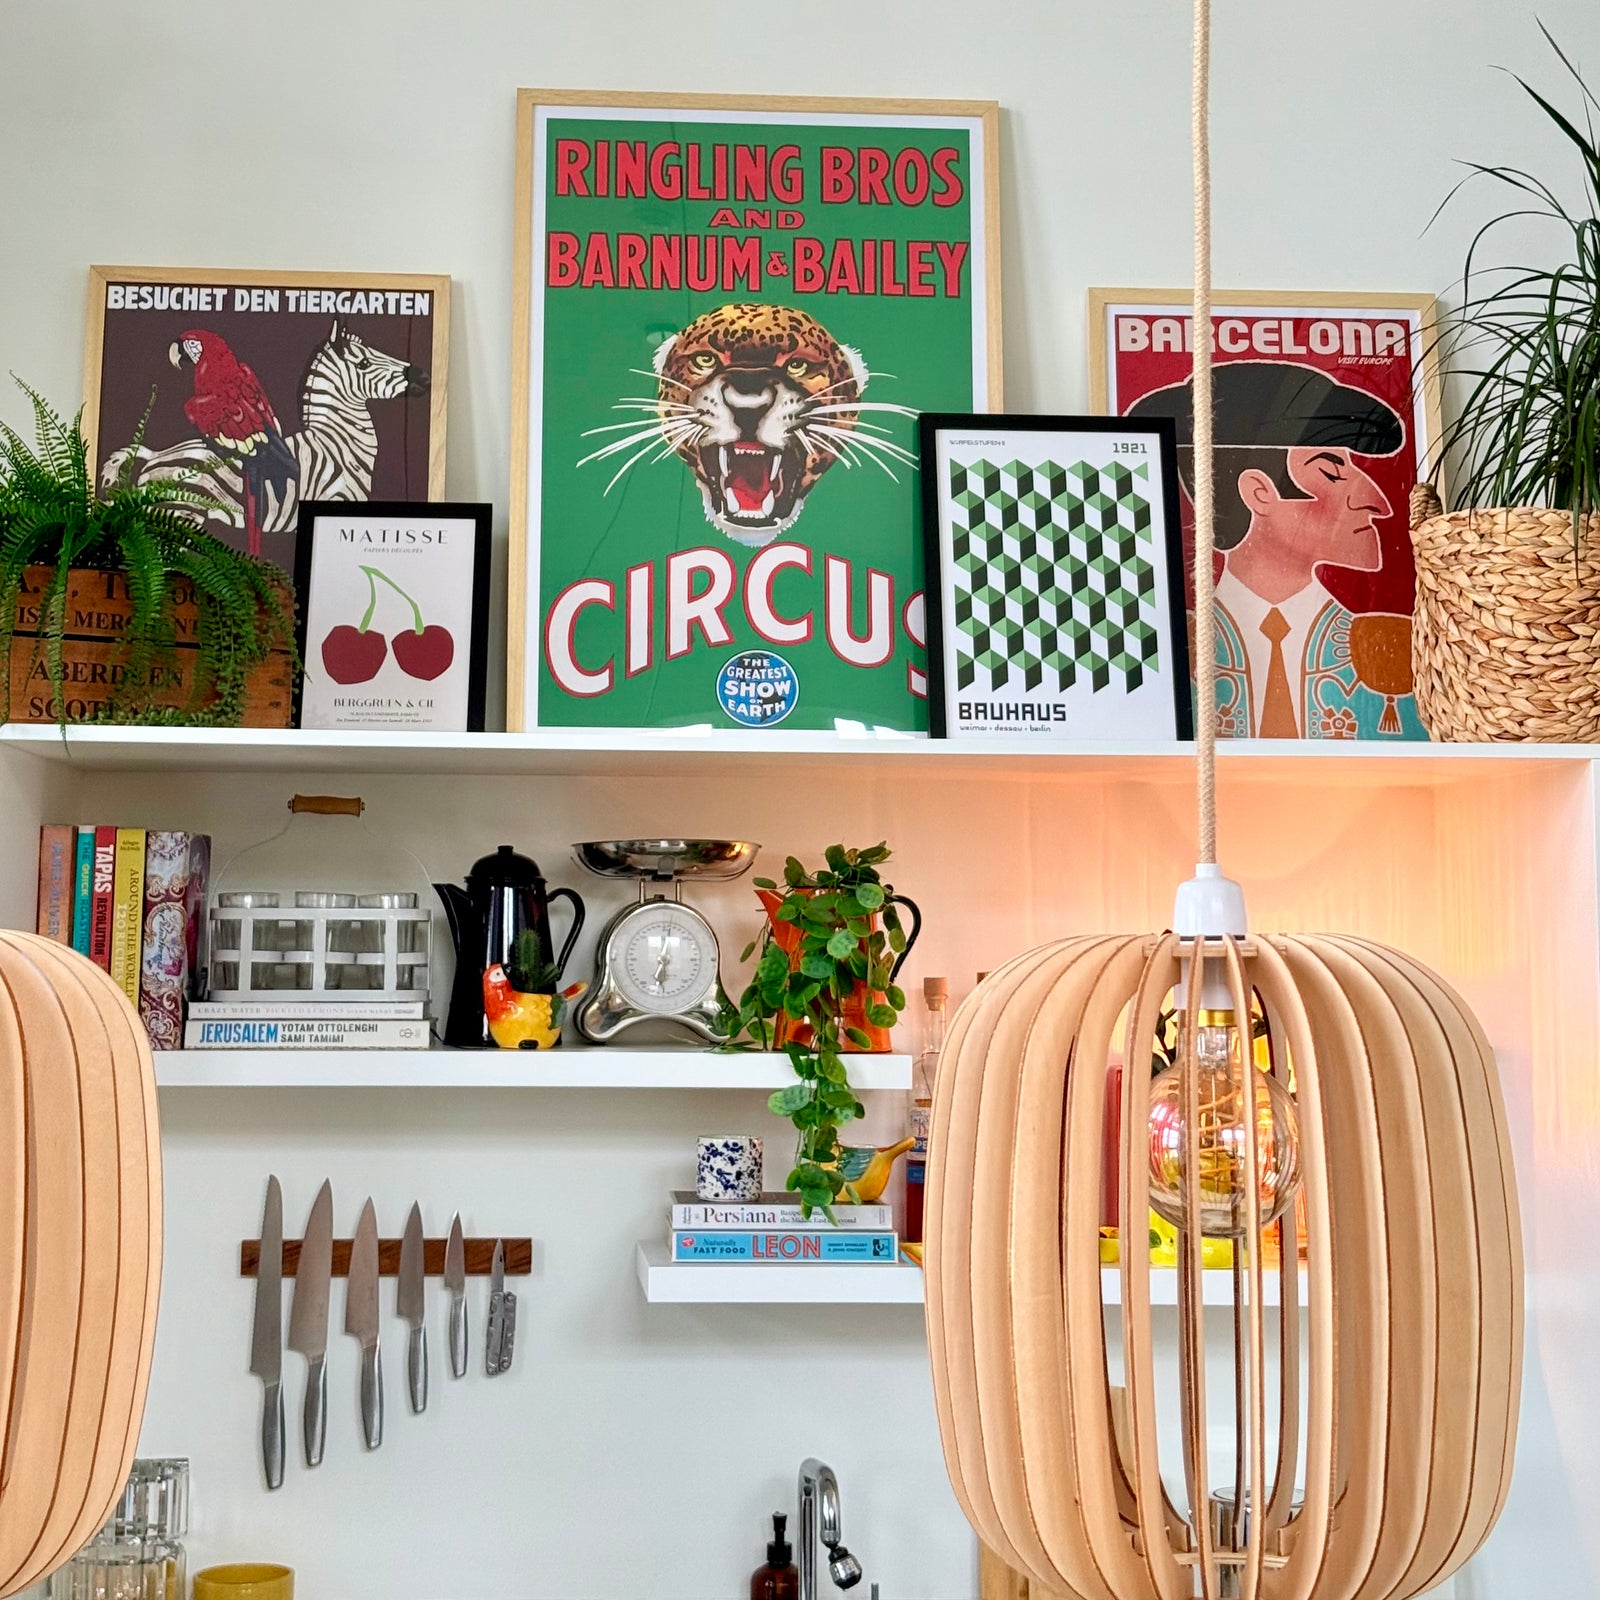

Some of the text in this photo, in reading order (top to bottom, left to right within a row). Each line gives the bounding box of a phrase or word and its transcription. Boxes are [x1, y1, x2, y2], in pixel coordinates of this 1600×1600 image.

[554, 138, 964, 208] RINGLING BROS
[709, 208, 805, 230] AND
[546, 231, 969, 298] BARNUM & BAILEY
[107, 285, 227, 311] BESUCHET
[234, 287, 279, 313] DEN
[1338, 356, 1394, 365] VISIT EUROPE
[1112, 442, 1148, 454] 1921
[339, 528, 449, 544] MATISSE
[742, 658, 770, 667] THE
[726, 666, 788, 680] GREATEST
[724, 679, 791, 698] SHOW
[727, 698, 786, 717] EARTH
[959, 702, 1067, 721] BAUHAUS
[959, 723, 1051, 732] weimar dessau berlin
[47, 841, 63, 937] JAMIE OLIVER
[79, 841, 91, 953] THE QUICK ROASTING
[94, 844, 114, 956] TAPAS REVOLUTION
[115, 903, 127, 982] 120 RECIPES
[125, 868, 139, 999] AROUND THE WORLD
[200, 1023, 279, 1043] JERUSALEM
[281, 1023, 378, 1032] YOTAM OTTOLENGHI
[281, 1034, 344, 1043] SAMI TAMIMI
[703, 1206, 776, 1223] Persiana
[703, 1238, 736, 1247] Naturally
[752, 1235, 821, 1258] LEON
